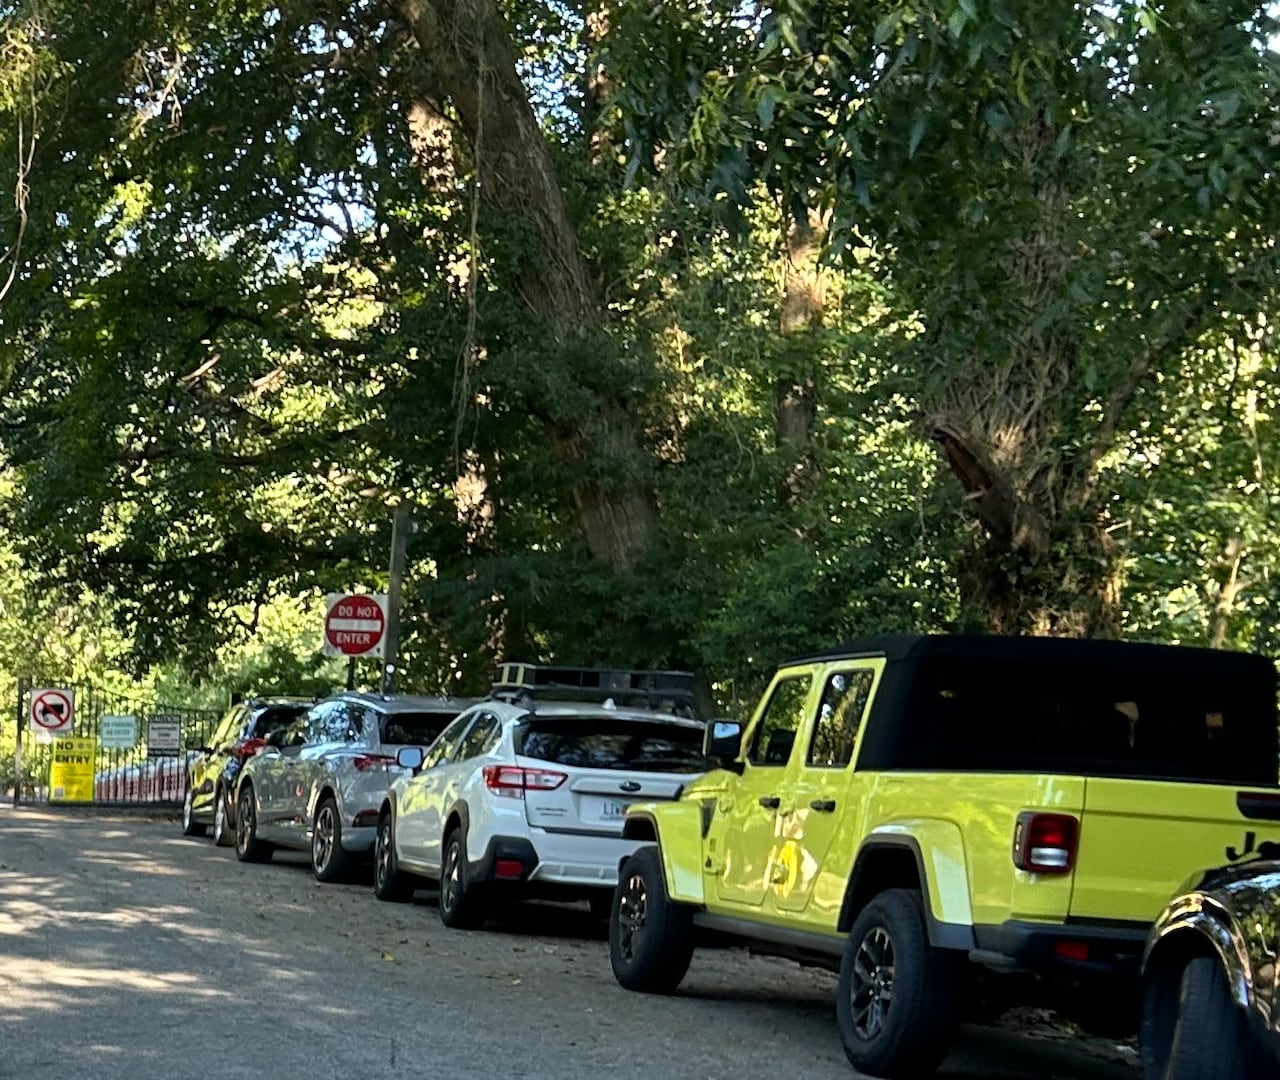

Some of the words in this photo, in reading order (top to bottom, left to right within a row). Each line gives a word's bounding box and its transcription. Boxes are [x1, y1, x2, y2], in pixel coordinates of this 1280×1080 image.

[338, 605, 353, 617] DO
[356, 606, 378, 618] NOT
[336, 632, 371, 644] ENTER
[56, 741, 74, 751] NO
[55, 754, 90, 764] ENTRY
